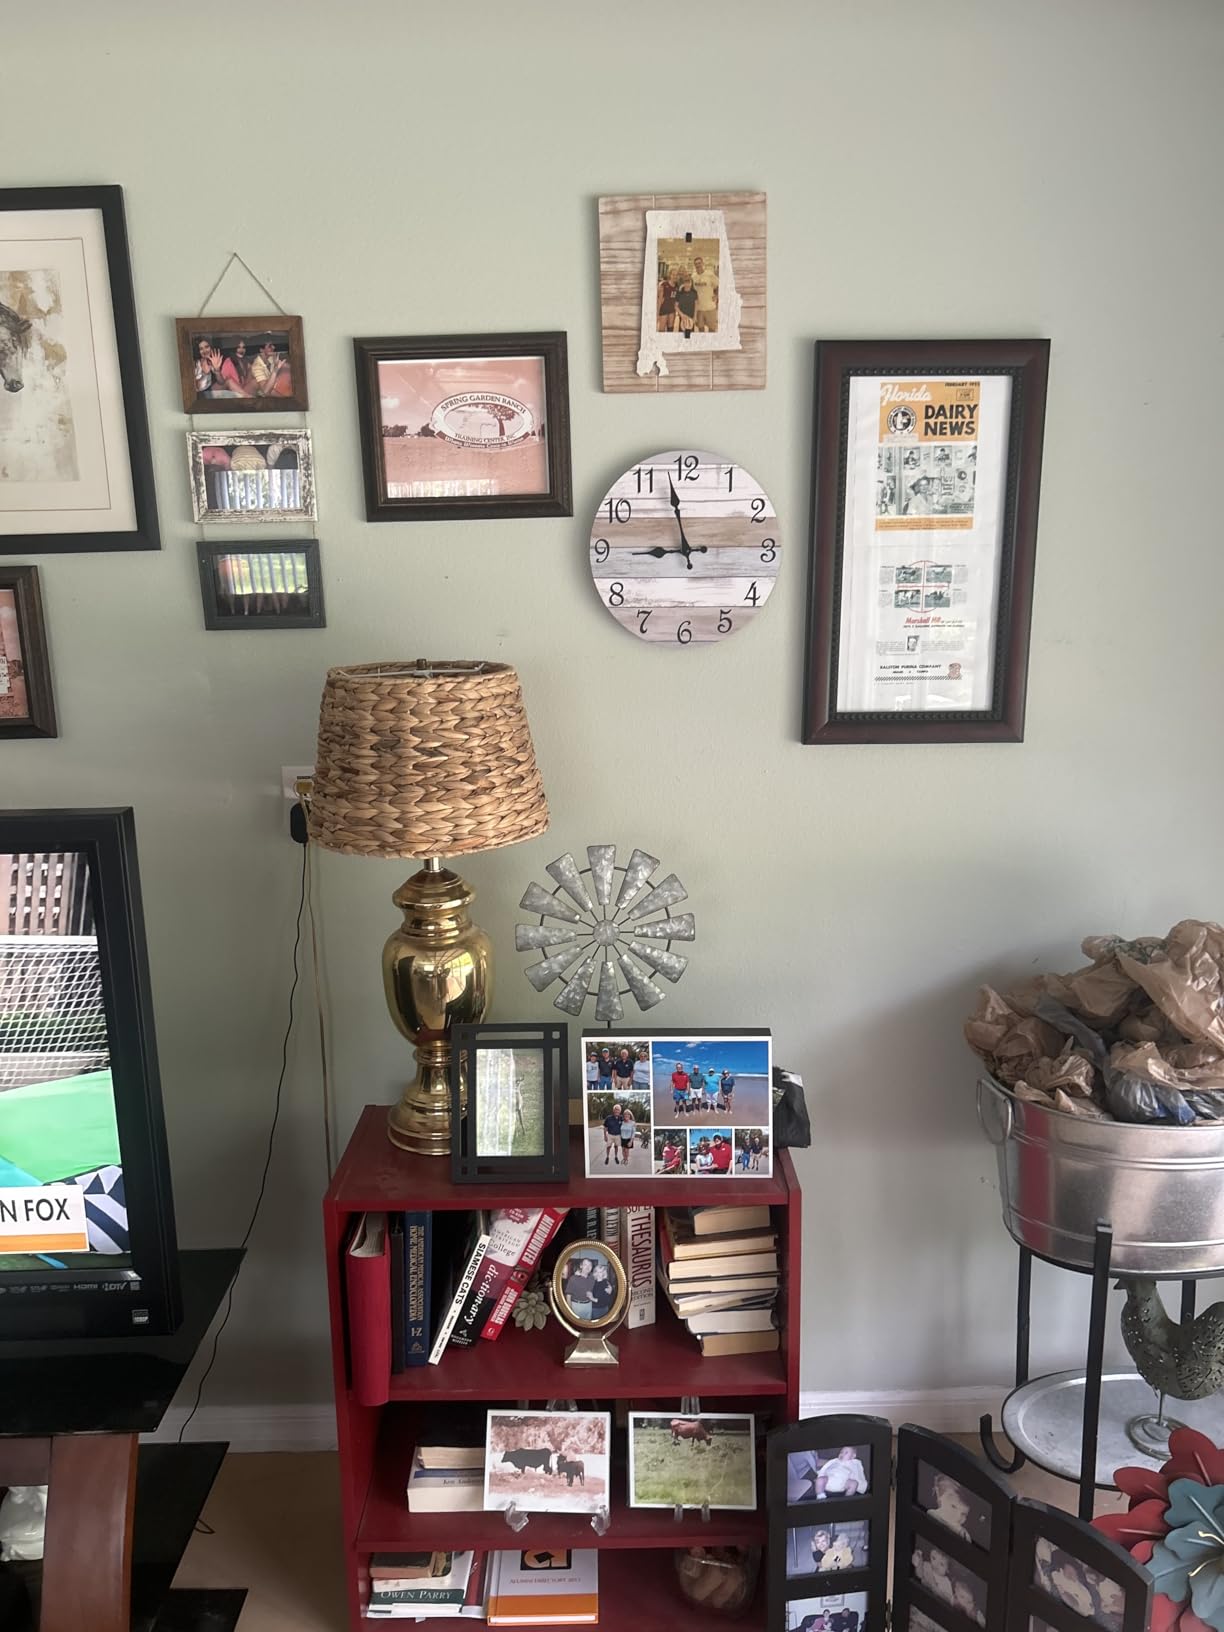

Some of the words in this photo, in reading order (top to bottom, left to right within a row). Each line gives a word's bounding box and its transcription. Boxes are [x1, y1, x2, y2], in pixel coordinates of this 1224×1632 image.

[441, 395, 468, 411] SPRING
[469, 394, 501, 402] GARDEN
[502, 398, 526, 414] RANCH
[880, 384, 932, 406] Florida
[924, 404, 978, 420] DAIRY
[455, 433, 482, 443] TRAINING
[924, 421, 975, 436] NEWS
[632, 467, 654, 494] 11
[673, 455, 700, 481] 12
[724, 466, 734, 493] 1
[604, 497, 632, 524] 10
[750, 498, 767, 523] 2
[594, 538, 610, 563] 9
[760, 538, 776, 563] 3
[608, 582, 624, 606] 8
[744, 580, 761, 607] 4
[636, 609, 653, 634] 7
[677, 620, 692, 645] 6
[717, 608, 733, 633] 5
[0, 1200, 17, 1222] N
[24, 1198, 70, 1222] FOX
[410, 1225, 418, 1245] HOME
[521, 1214, 555, 1265] MINDHUNTER
[607, 1218, 618, 1237] LEVIN
[490, 1238, 516, 1256] College
[631, 1213, 652, 1289] THESAURUS
[410, 1246, 418, 1274] MEDICAL
[465, 1242, 486, 1281] SIAMESE
[409, 1275, 417, 1321] ENCYCLOPEDIA
[455, 1282, 469, 1304] CATS
[381, 1591, 415, 1599] OWEN
[420, 1590, 452, 1599] PARRY
